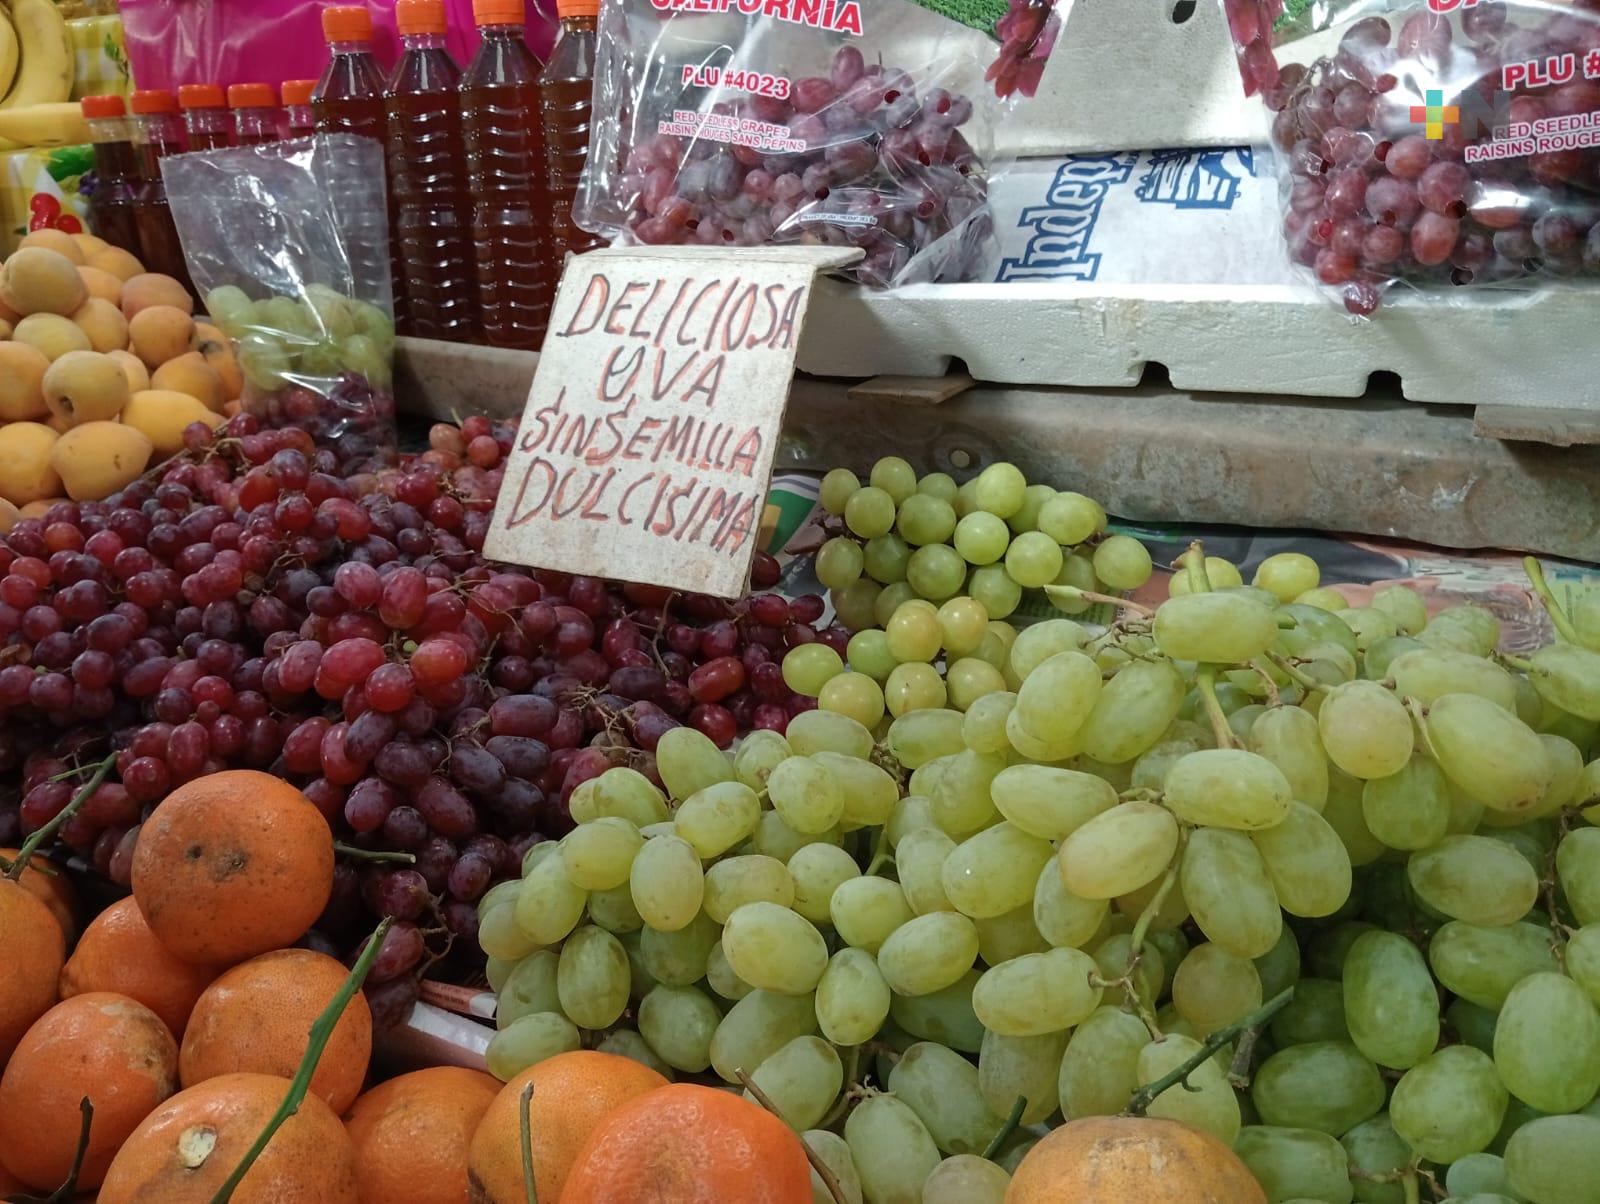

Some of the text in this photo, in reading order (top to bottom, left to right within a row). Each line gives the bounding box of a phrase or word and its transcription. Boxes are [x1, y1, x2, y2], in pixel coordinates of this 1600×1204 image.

[682, 66, 790, 99] PLU #4023
[1504, 54, 1574, 90] PLU
[658, 122, 697, 137] RAISINS
[732, 132, 761, 148] SANS
[674, 111, 790, 138] RED SEDLESS GRAPES
[1495, 122, 1531, 140] RED
[1466, 138, 1535, 163] RAISINS
[996, 154, 1132, 282] Indep
[556, 273, 805, 351] DELICIOSA
[505, 456, 760, 557] DULCISIMA
